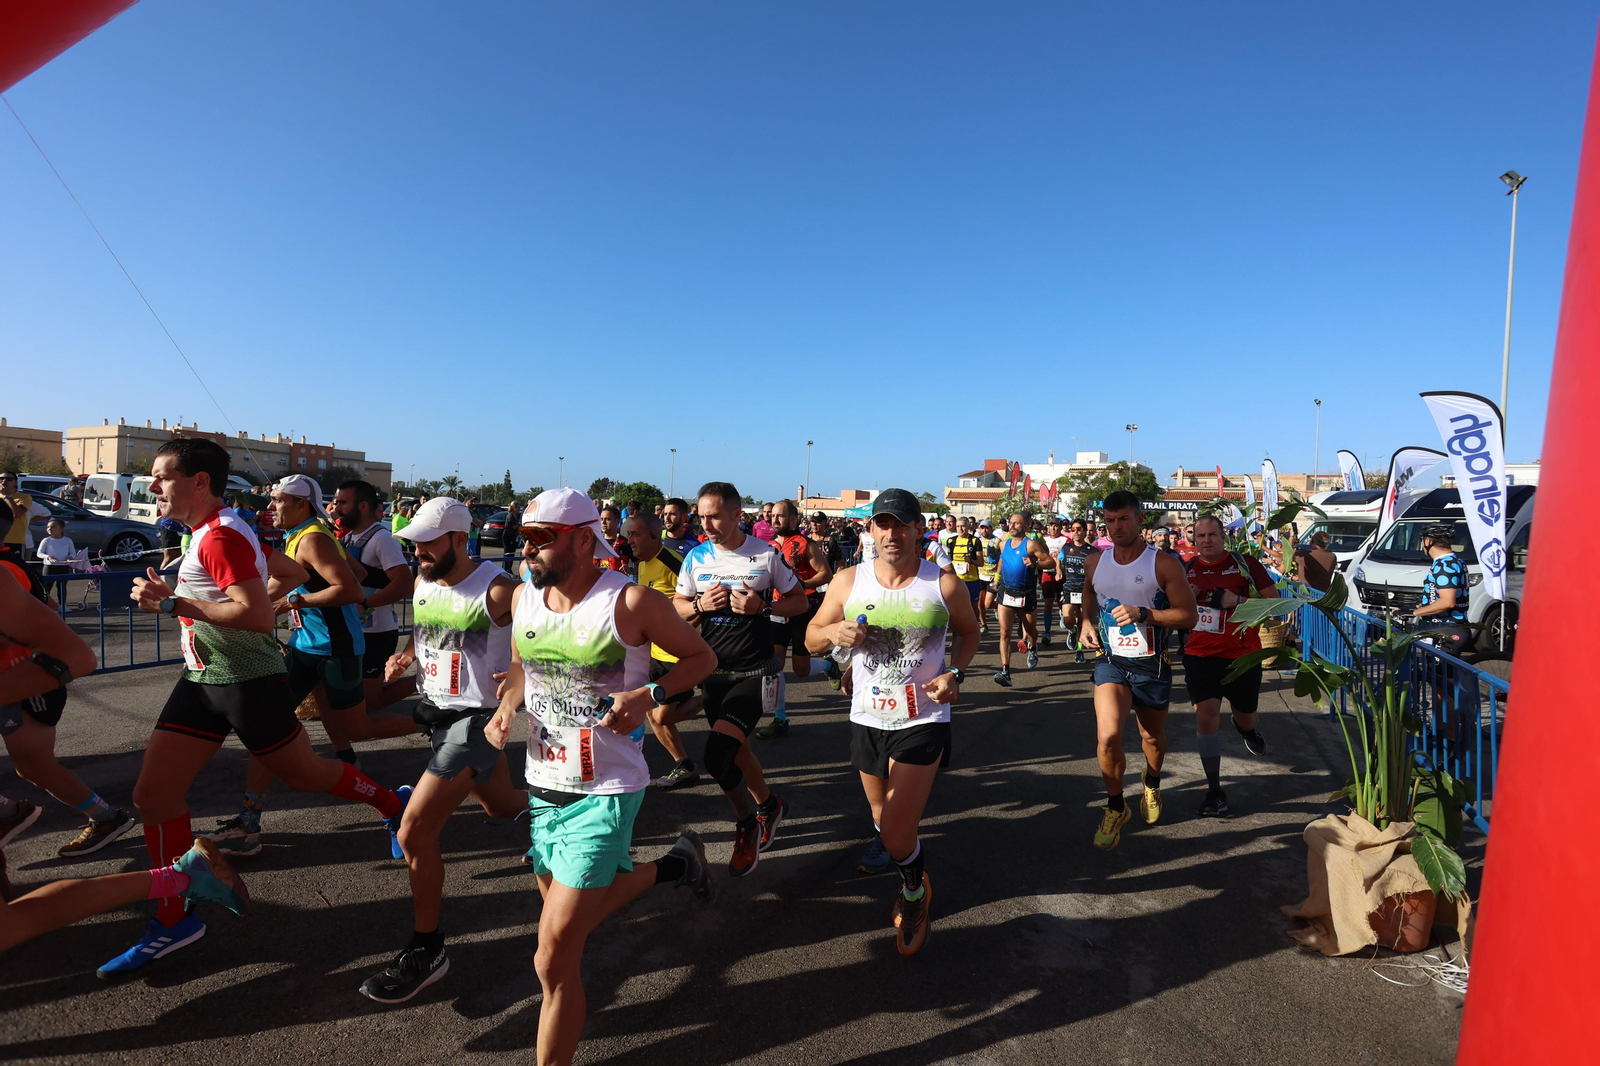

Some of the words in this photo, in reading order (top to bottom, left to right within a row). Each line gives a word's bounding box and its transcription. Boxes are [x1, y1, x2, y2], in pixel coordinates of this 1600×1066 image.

[1142, 502, 1167, 510] TRAIL
[1168, 502, 1198, 510] PIRATA
[1198, 614, 1213, 624] 03
[1117, 637, 1139, 647] 225
[424, 662, 438, 677] 68
[863, 652, 879, 672] Los
[450, 659, 459, 689] PIRATA
[529, 692, 548, 717] Los
[871, 697, 897, 710] 179
[907, 690, 918, 718] PIRATA
[538, 742, 567, 764] 164
[580, 736, 592, 775] PIRATA
